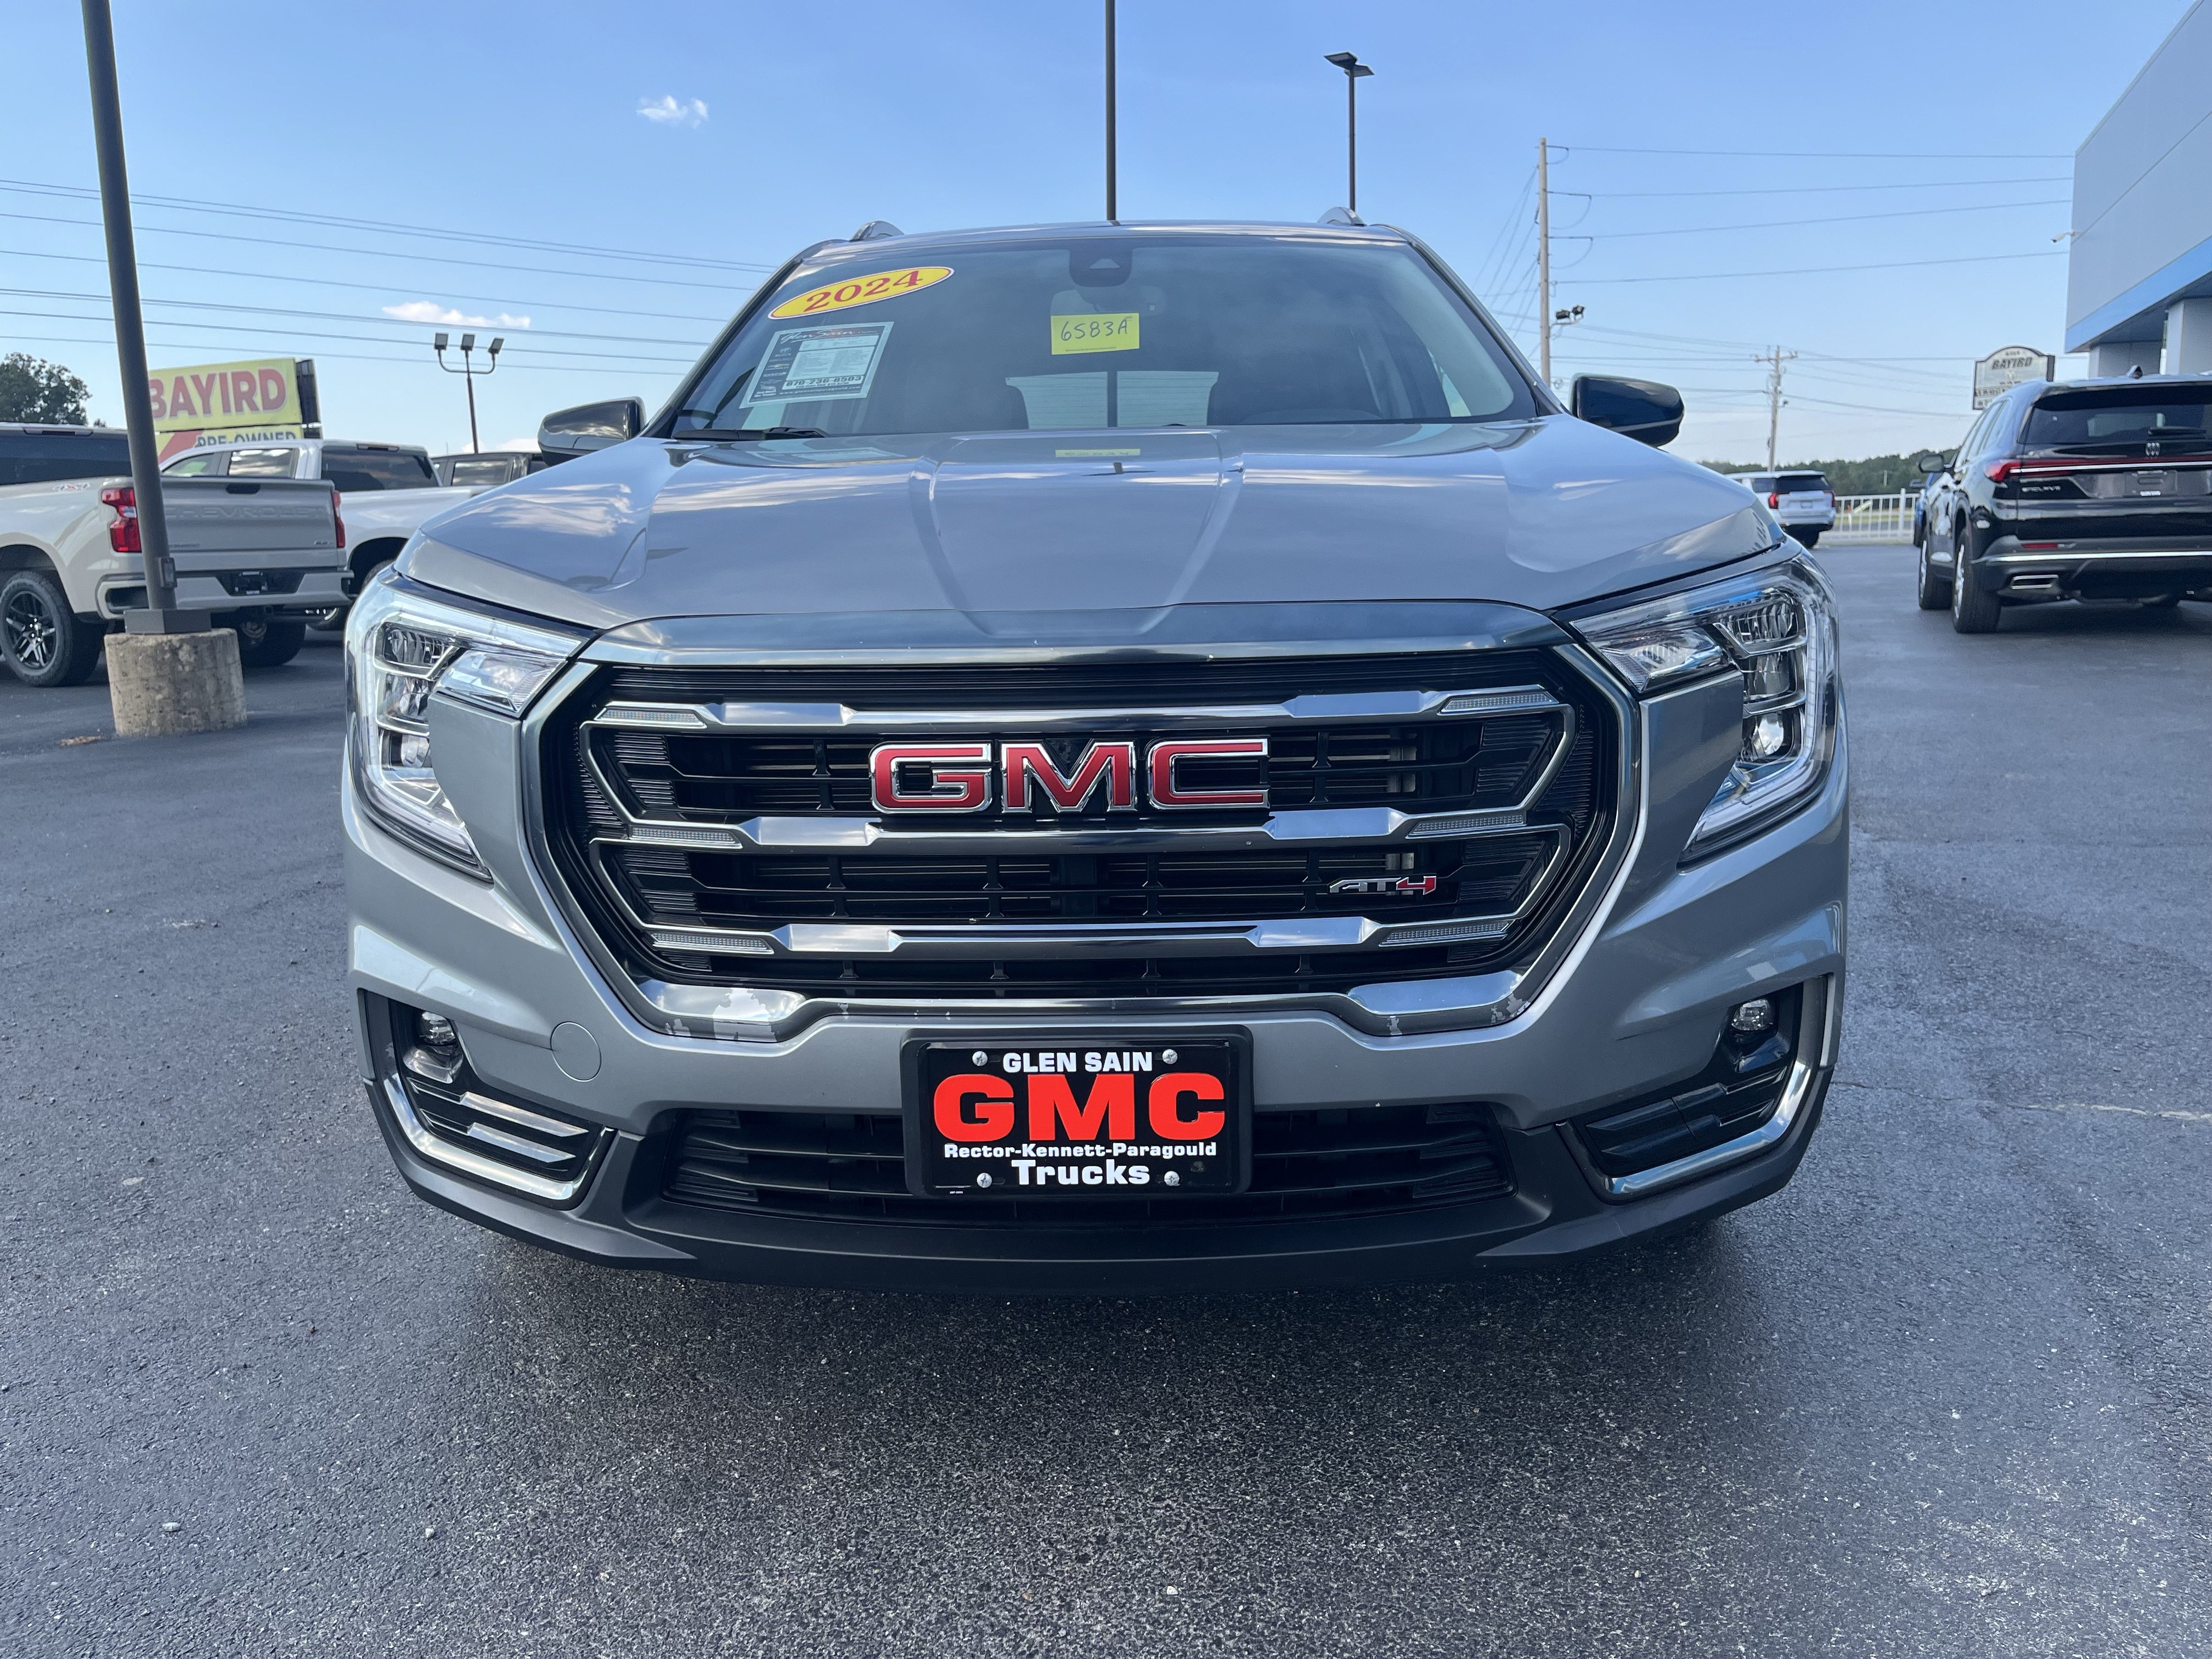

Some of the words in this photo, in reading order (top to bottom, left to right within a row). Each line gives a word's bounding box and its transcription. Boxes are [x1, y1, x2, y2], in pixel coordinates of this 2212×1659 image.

[803, 270, 923, 313] 2024
[1060, 319, 1128, 341] 6583A
[149, 368, 286, 419] BAYIRD
[869, 737, 1270, 815] GMC
[1329, 876, 1437, 896] AT4
[1003, 1052, 1076, 1073] GLEN
[1085, 1051, 1152, 1072] SAIN
[933, 1072, 1225, 1142] GMC
[944, 1142, 1217, 1160] Rector-Kennett-Paragould
[1011, 1159, 1150, 1186] Trucks
